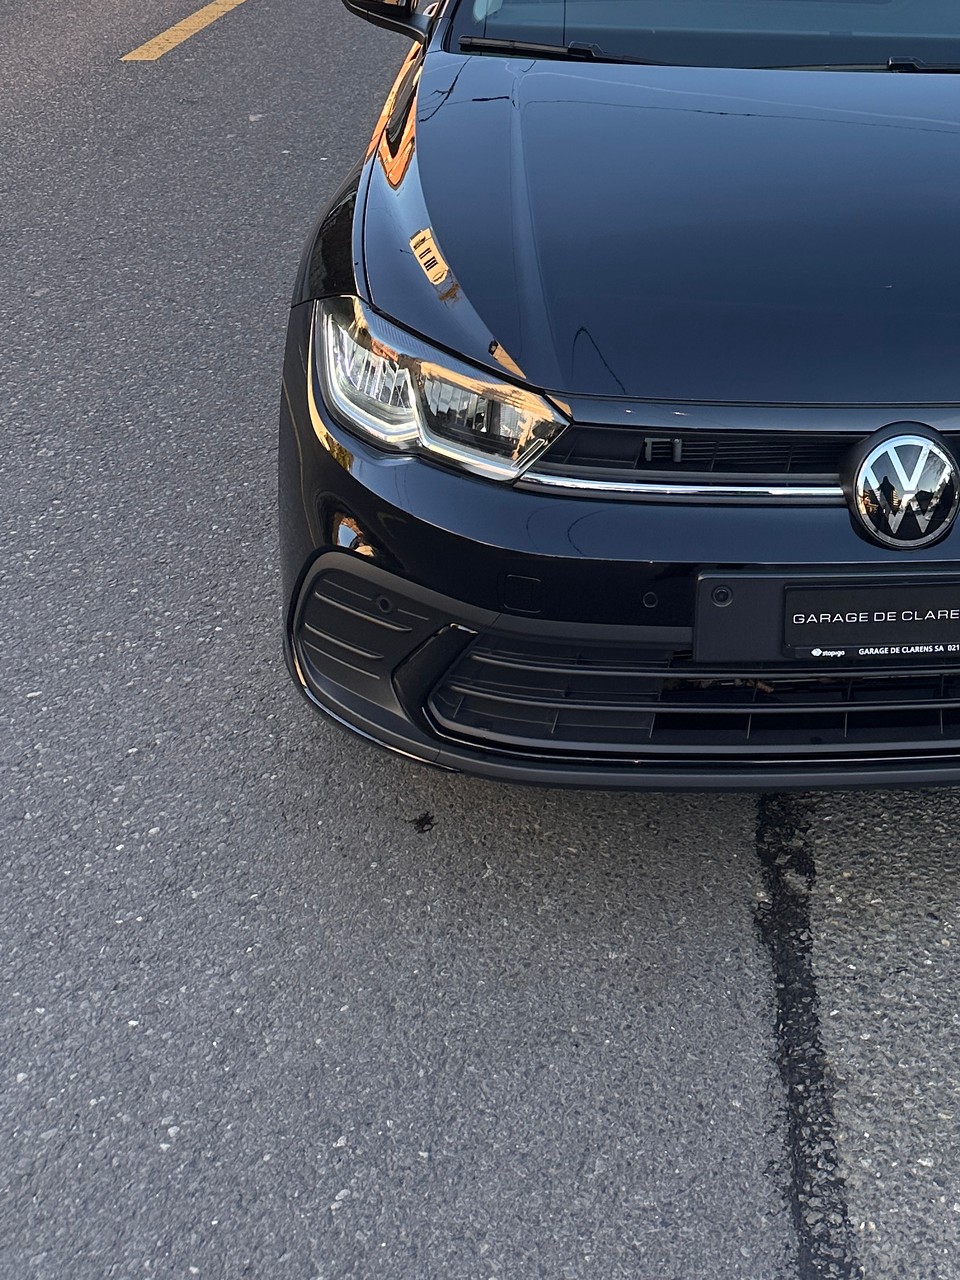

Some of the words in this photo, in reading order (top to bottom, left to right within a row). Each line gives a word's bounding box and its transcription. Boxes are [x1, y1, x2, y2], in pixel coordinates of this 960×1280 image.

[792, 612, 869, 624] GARAGE
[873, 611, 897, 622] DE
[858, 647, 889, 655] GARAGE
[901, 645, 934, 654] CLARENS
[947, 644, 960, 652] 021
